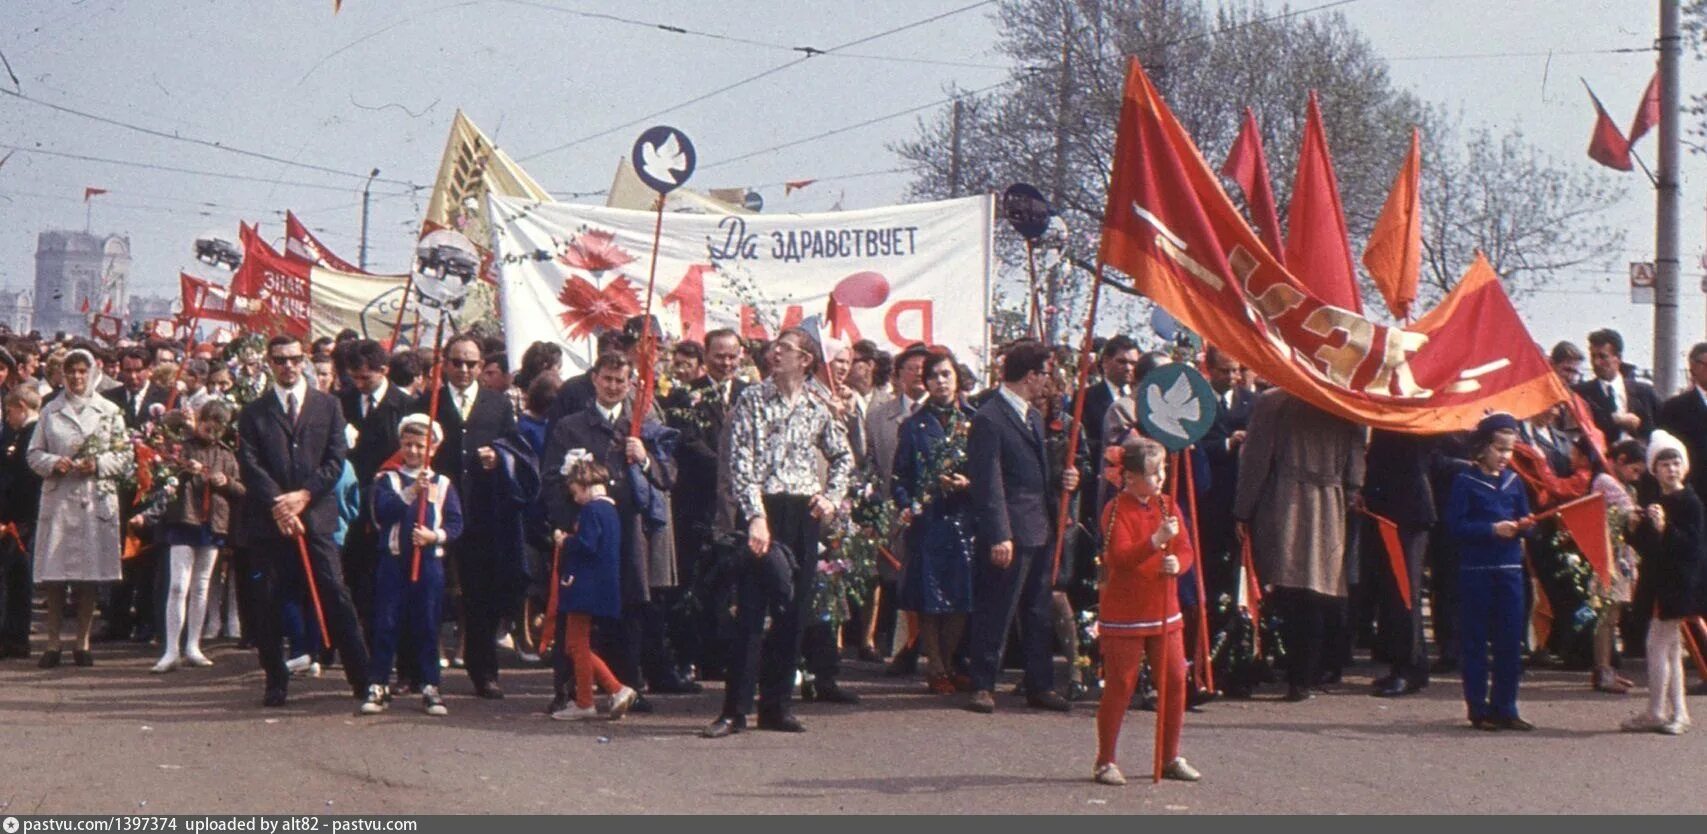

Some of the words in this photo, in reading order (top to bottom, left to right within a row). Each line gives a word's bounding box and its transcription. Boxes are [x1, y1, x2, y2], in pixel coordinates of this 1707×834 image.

[706, 215, 758, 260] Да
[771, 226, 919, 263] ЗДРАВСТВУЕТ
[271, 294, 311, 320] КАЧЕ
